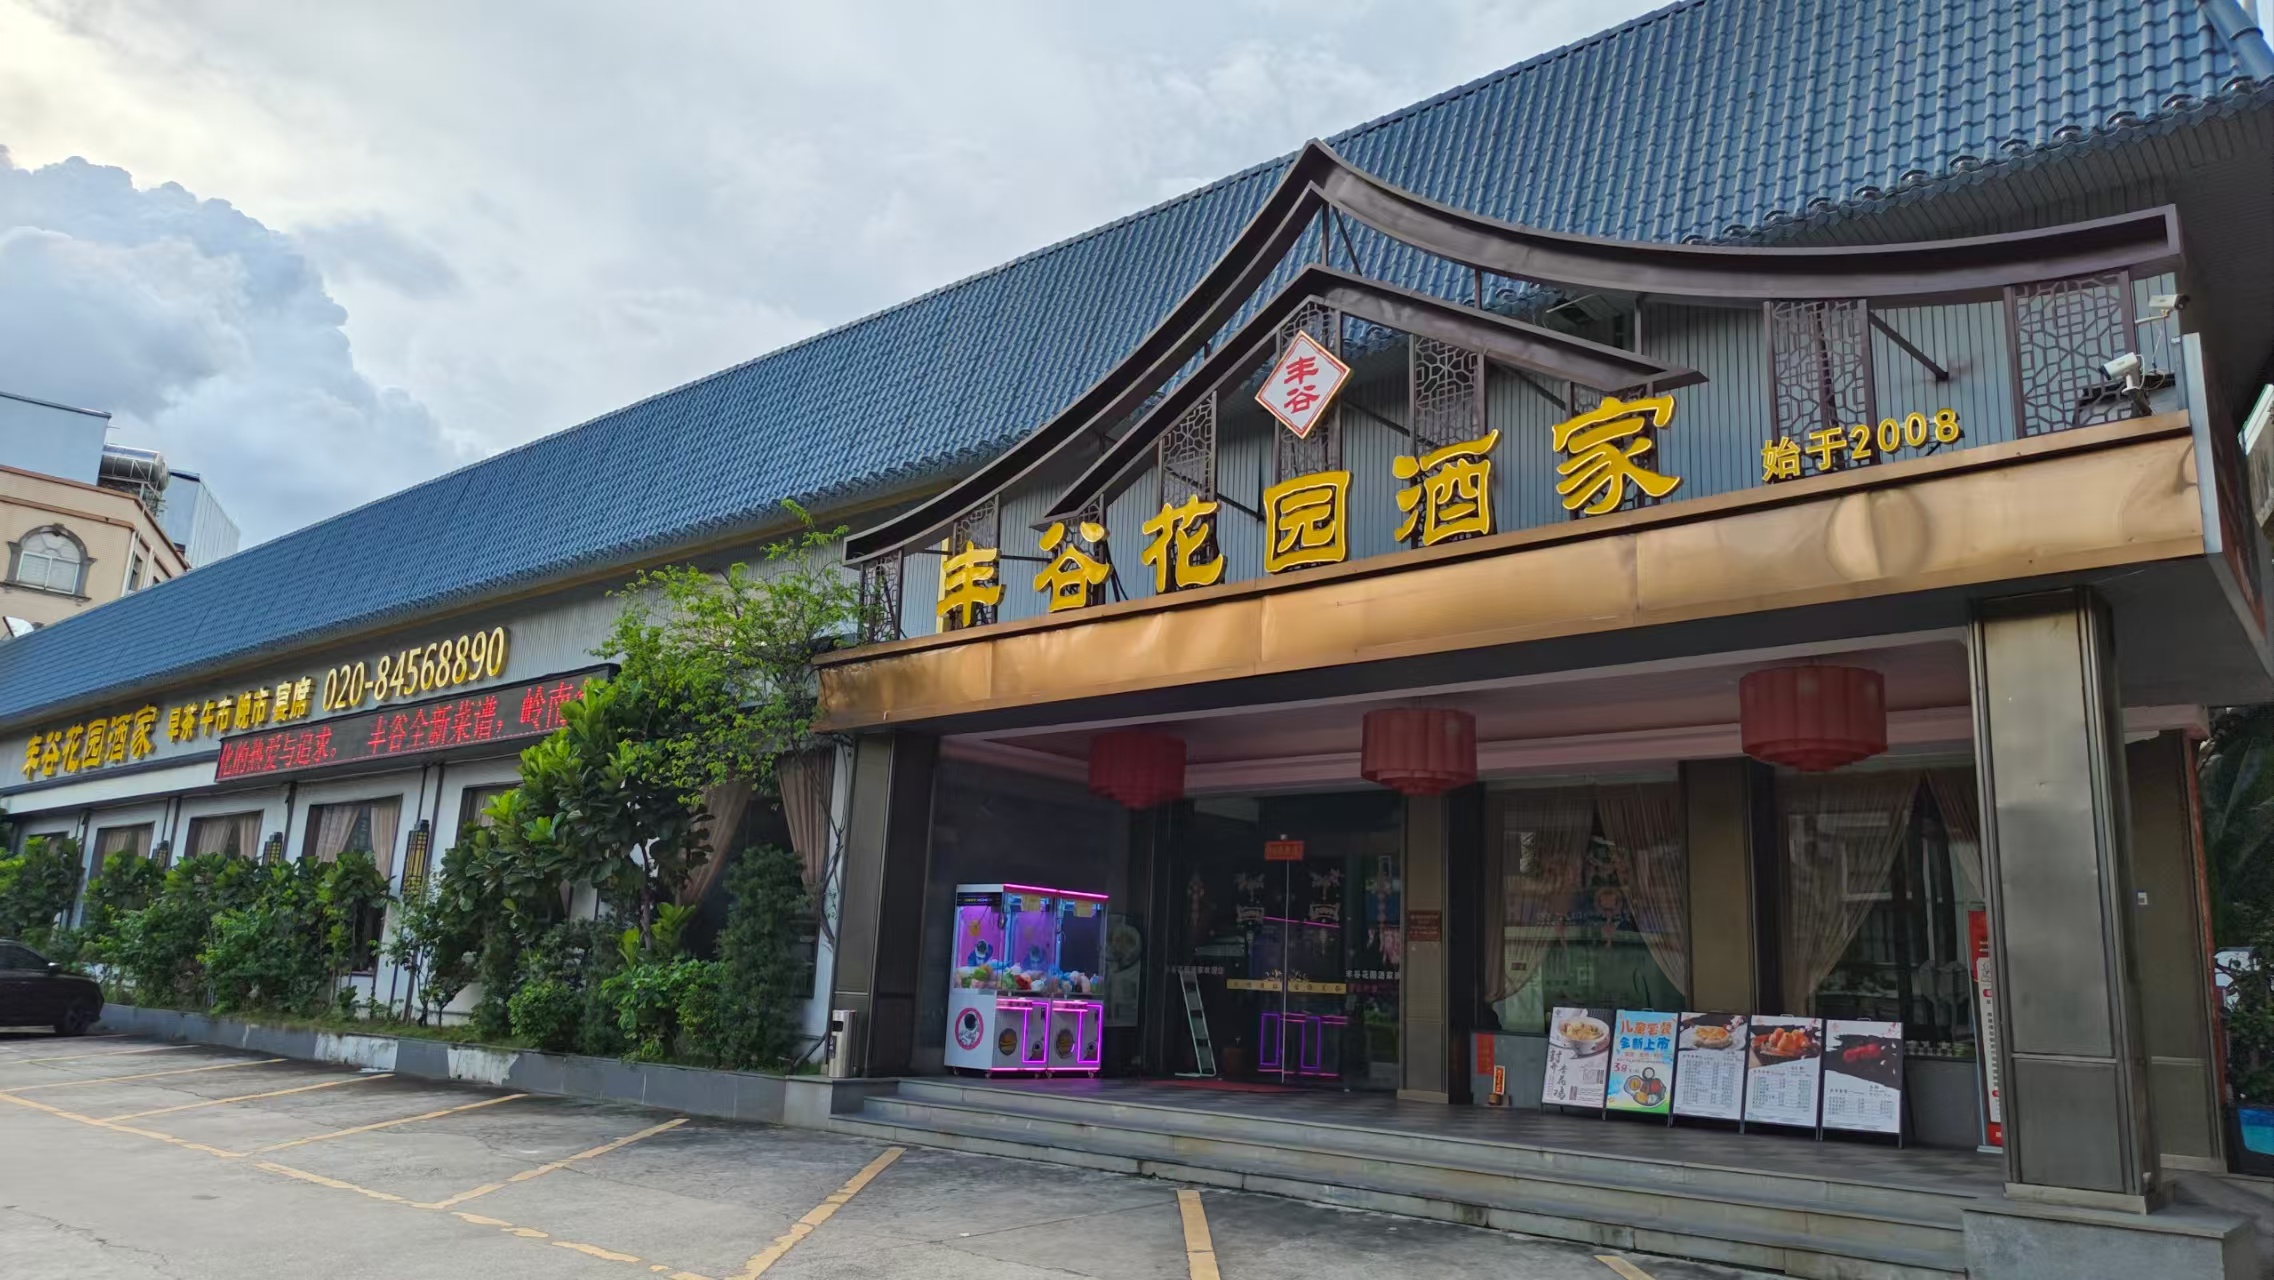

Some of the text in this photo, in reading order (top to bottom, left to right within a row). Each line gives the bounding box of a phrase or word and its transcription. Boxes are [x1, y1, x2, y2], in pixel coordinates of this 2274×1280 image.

[1283, 355, 1321, 414] 丰谷
[1761, 407, 1961, 483] 始于2008
[936, 395, 1683, 627] 丰谷花园酒家
[22, 626, 510, 780] 丰谷花园酒家 早茶 午市 晚市 宴席 020-84568890
[1619, 1037, 1671, 1051] 全新上市
